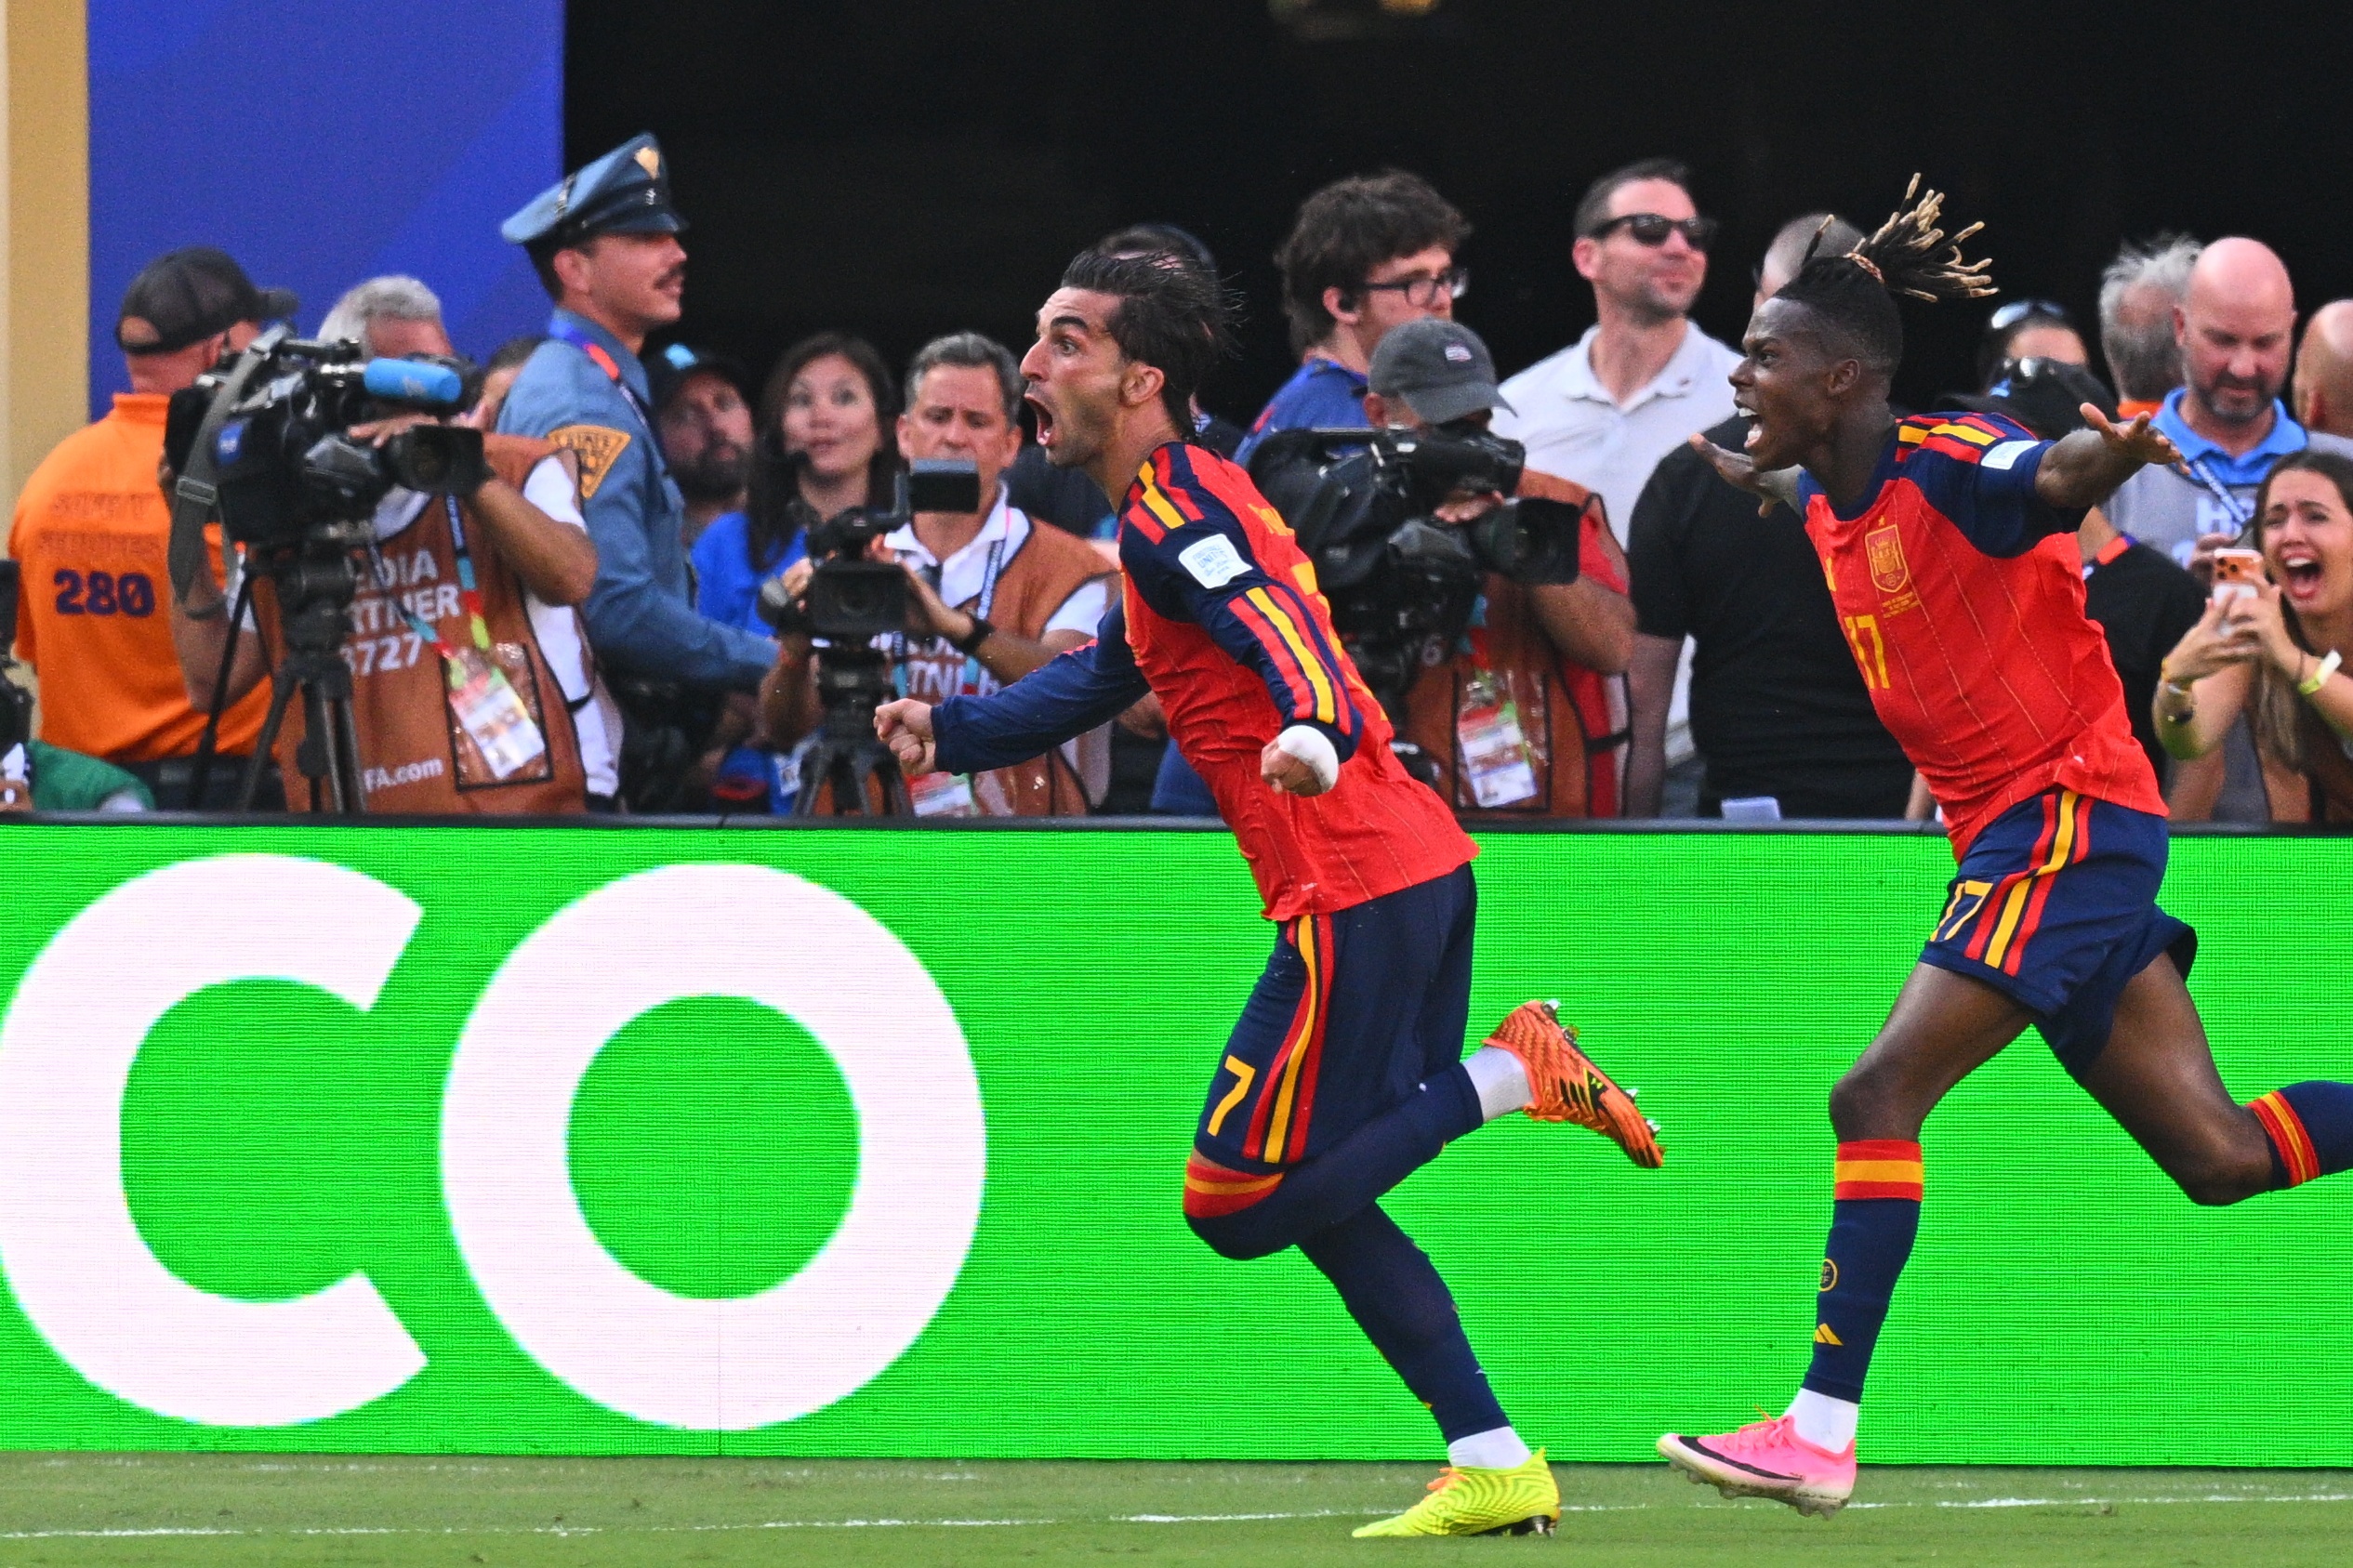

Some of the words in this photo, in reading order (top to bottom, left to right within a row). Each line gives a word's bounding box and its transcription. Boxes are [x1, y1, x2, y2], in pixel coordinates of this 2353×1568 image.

[53, 568, 156, 618] 280
[1844, 614, 1891, 690] 17
[364, 758, 444, 793] FA.com
[1929, 879, 1994, 942] 17
[1207, 1054, 1256, 1137] 7
[0, 852, 986, 1431] CO
